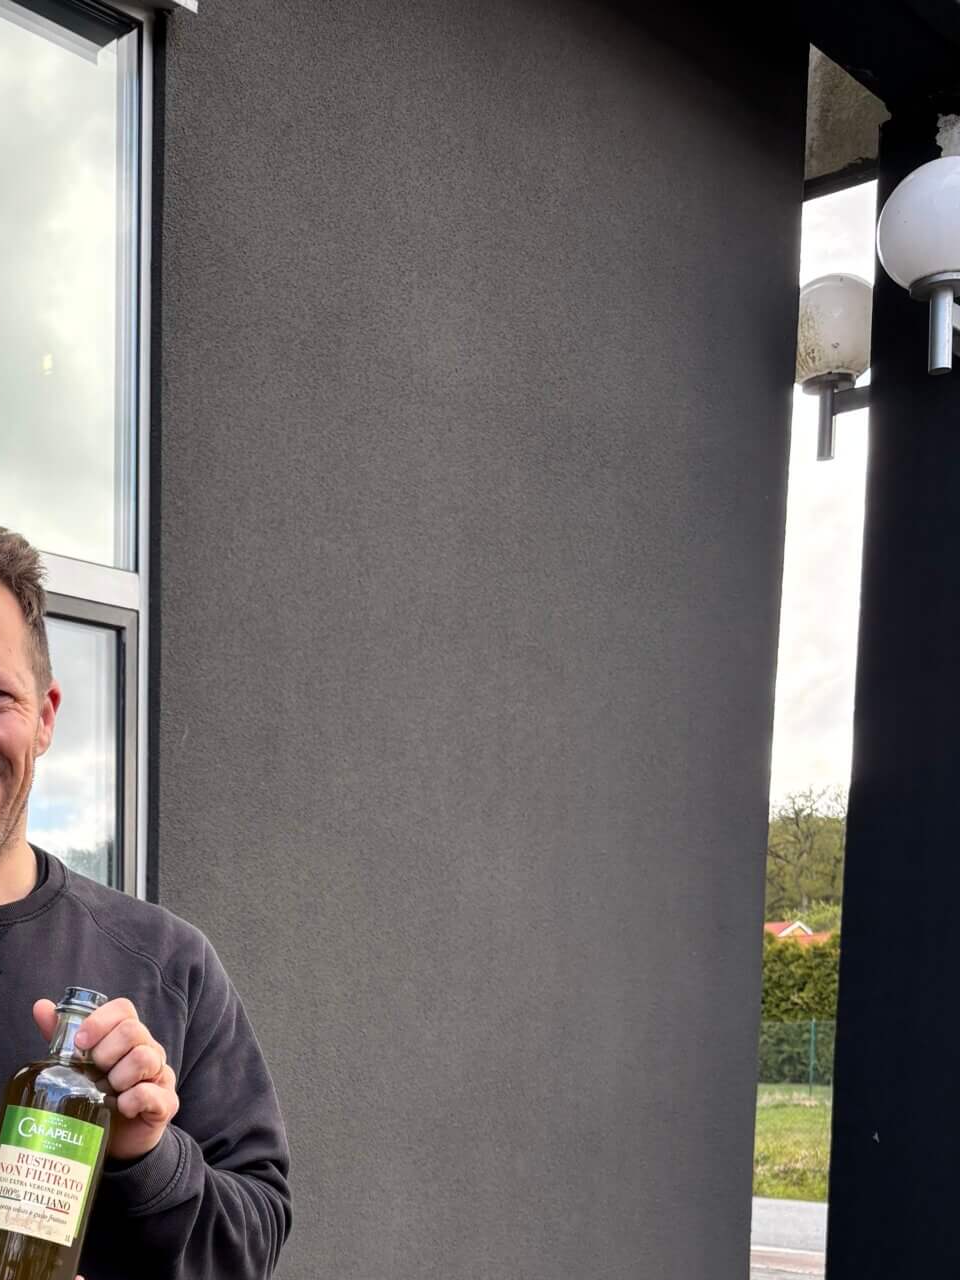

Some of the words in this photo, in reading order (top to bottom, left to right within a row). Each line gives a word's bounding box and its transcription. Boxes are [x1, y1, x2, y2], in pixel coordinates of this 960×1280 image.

[18, 1116, 84, 1146] CARAPELLI
[0, 1162, 23, 1176] NON
[25, 1167, 83, 1193] FILTRATO
[17, 1153, 71, 1175] RUSTICO
[0, 1185, 21, 1199] 100%
[23, 1190, 71, 1211] ITALIANO
